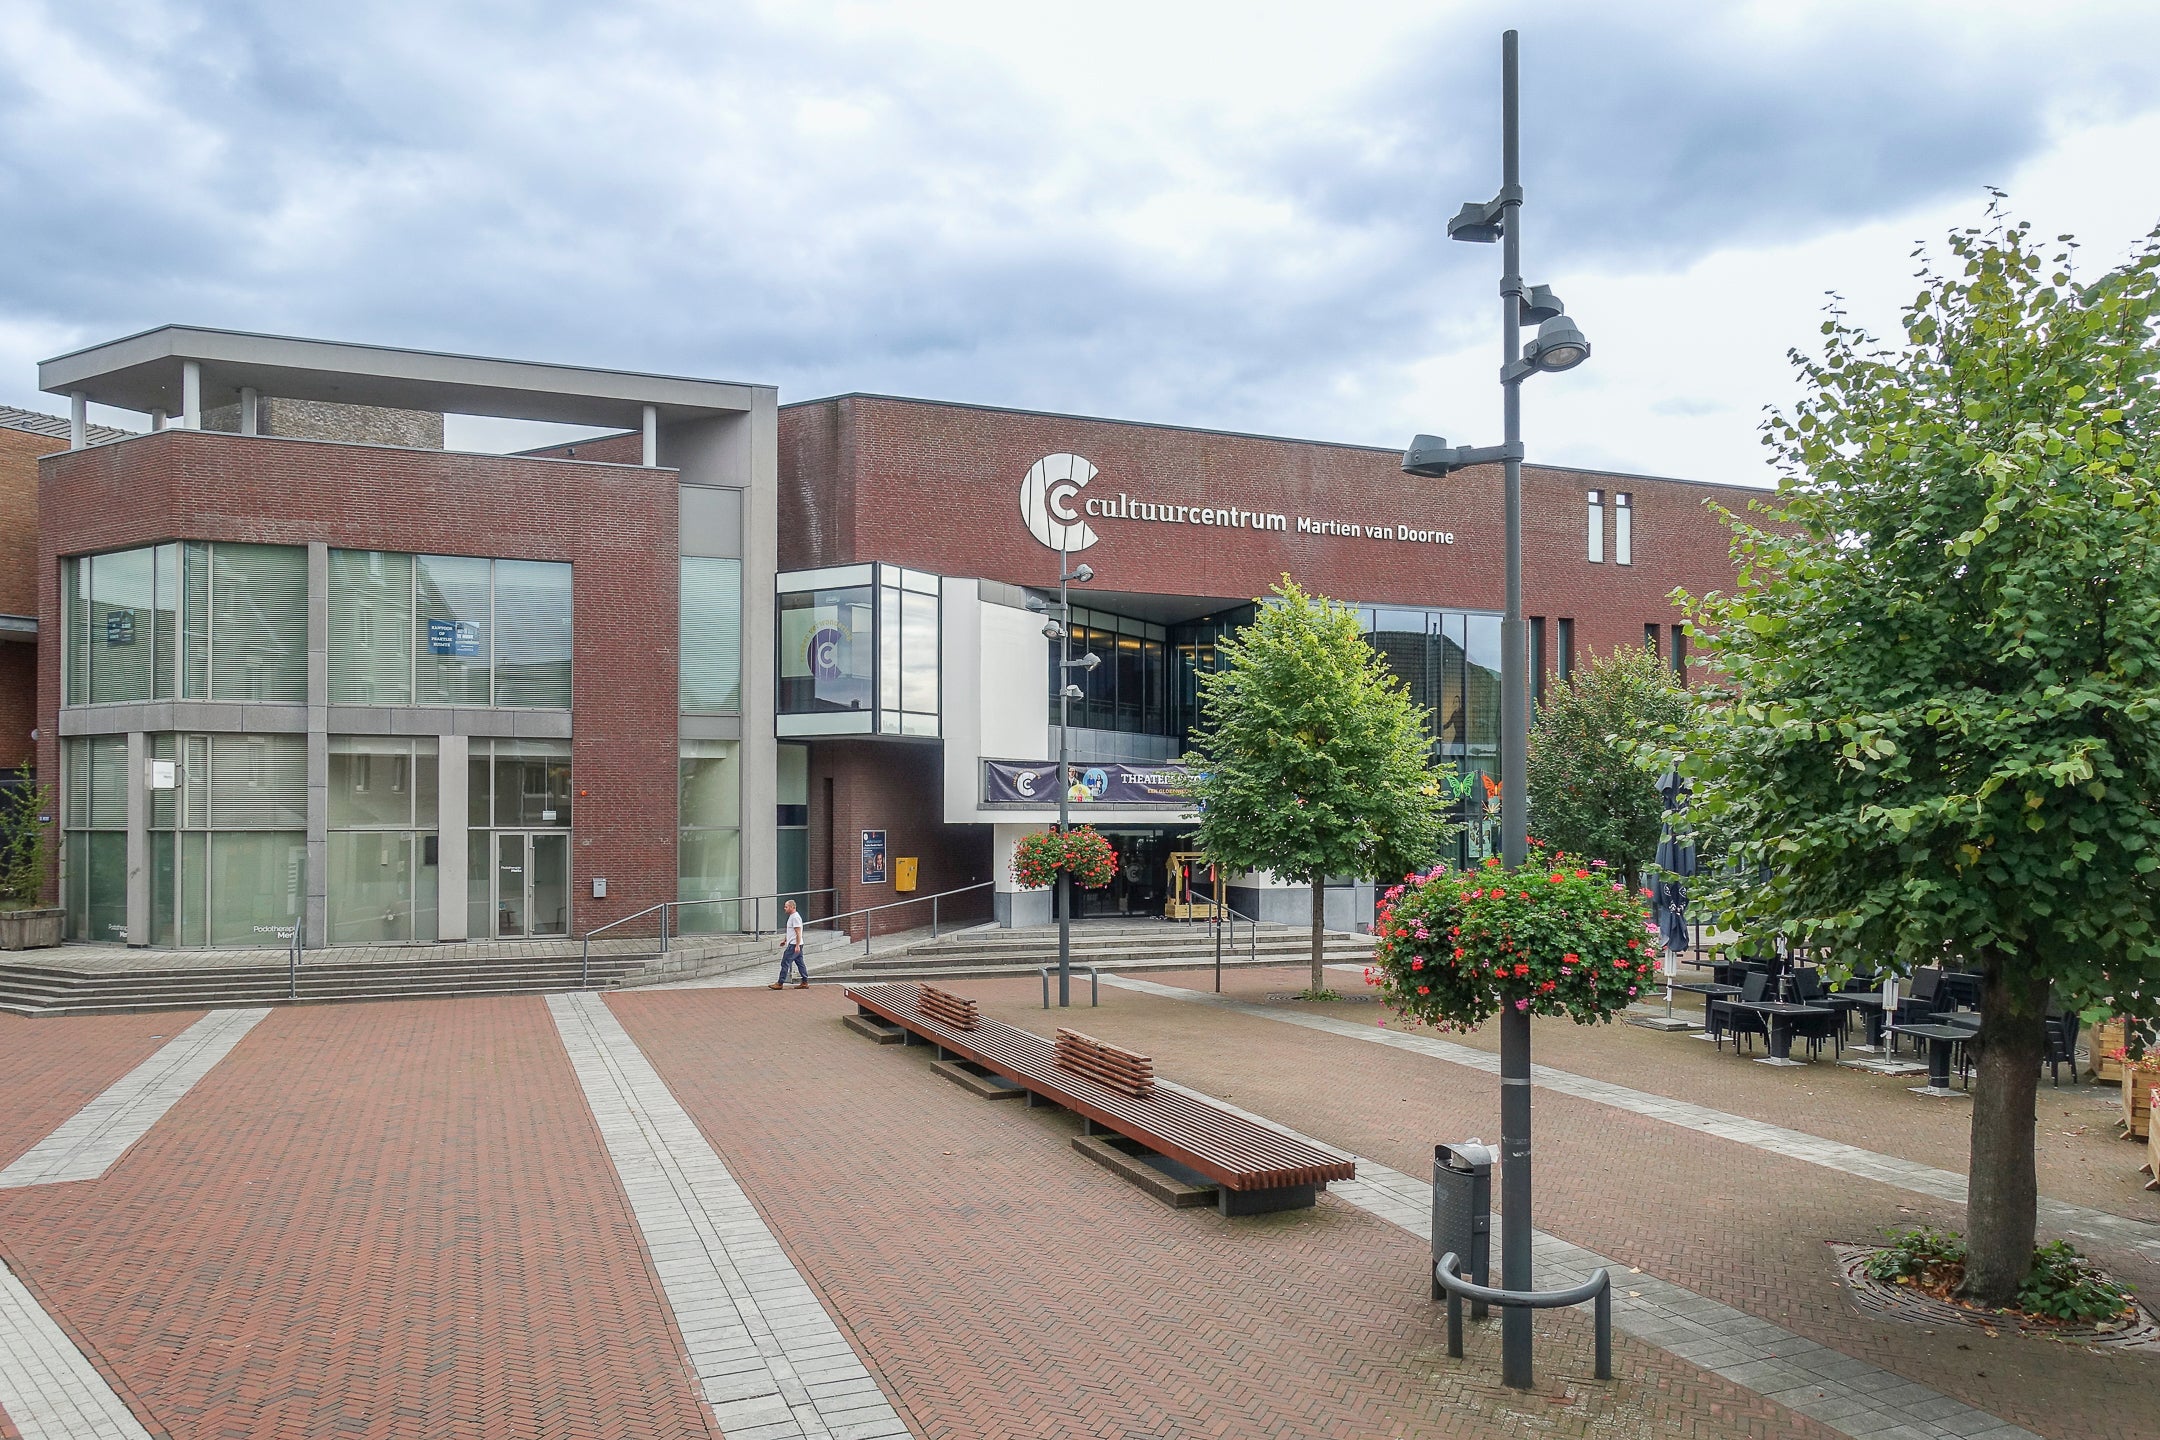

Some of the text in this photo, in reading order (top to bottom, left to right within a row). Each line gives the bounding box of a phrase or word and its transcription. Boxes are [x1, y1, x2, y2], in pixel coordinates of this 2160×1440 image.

[1085, 493, 1454, 545] cultuurcentrum Martien van Doorne
